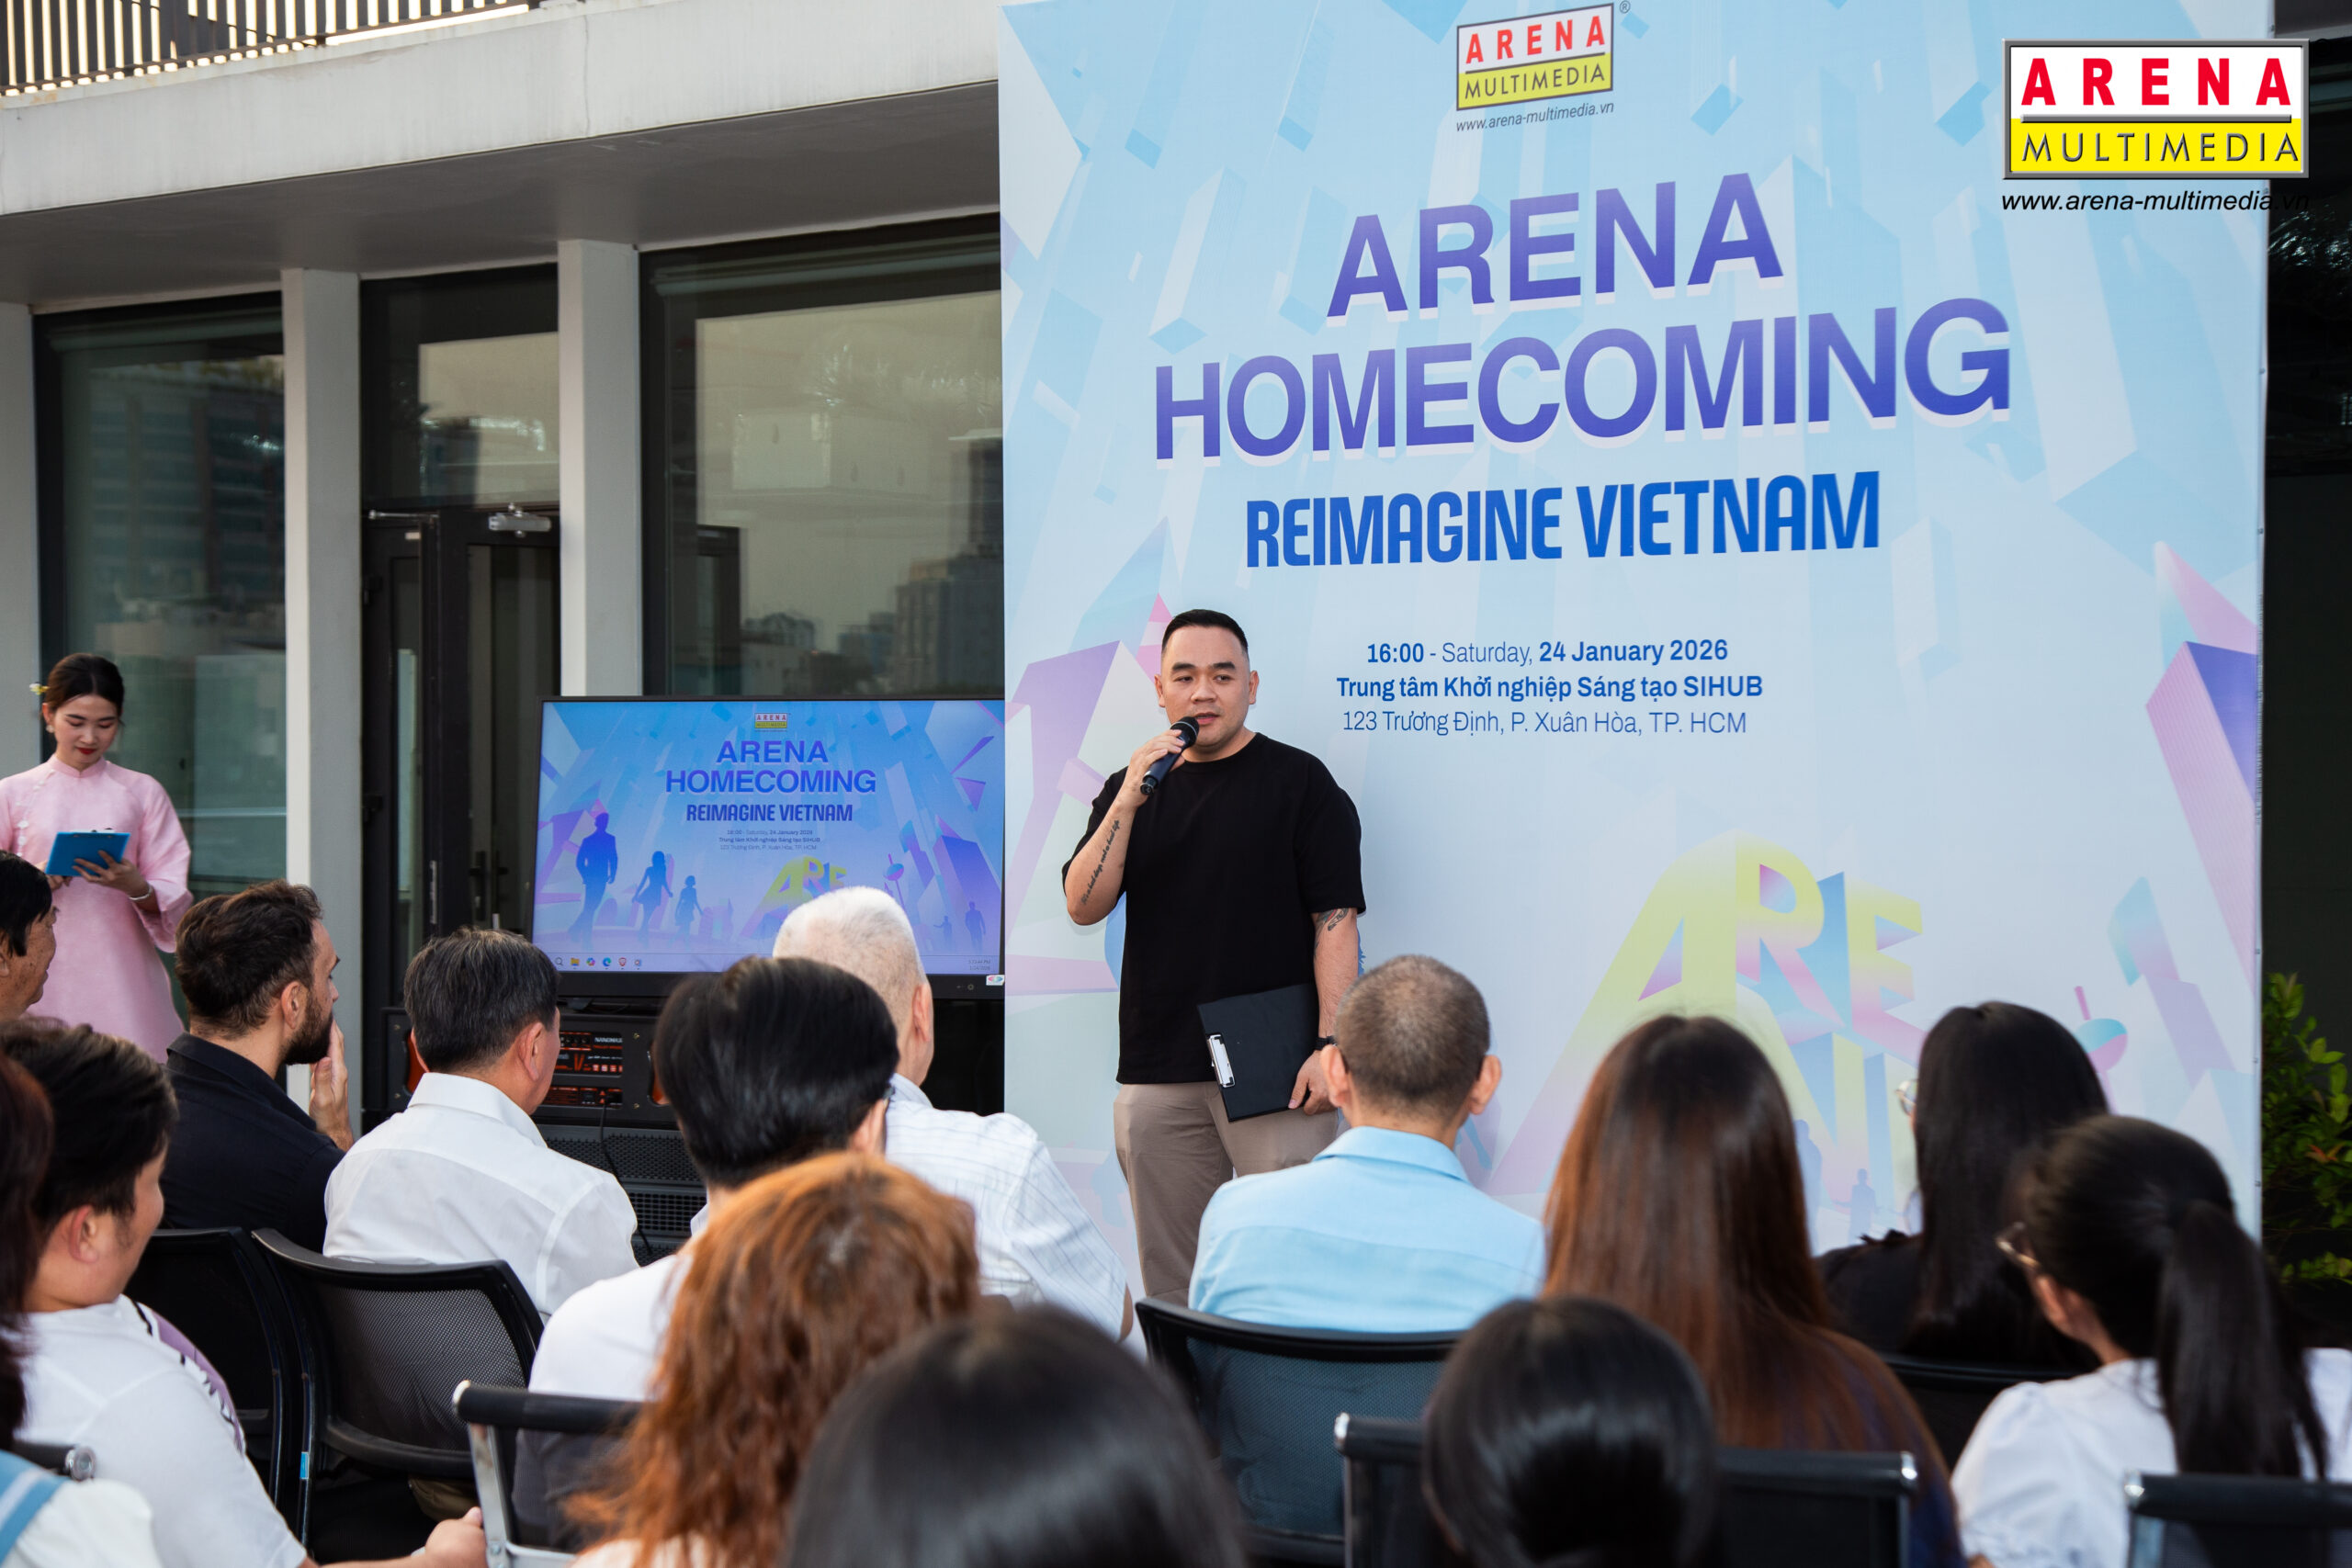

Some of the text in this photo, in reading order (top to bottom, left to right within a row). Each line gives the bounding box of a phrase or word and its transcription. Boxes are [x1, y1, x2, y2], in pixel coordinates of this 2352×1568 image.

[1465, 15, 1606, 64] ARENA
[1464, 62, 1606, 100] MULTIMEDIA
[1456, 102, 1615, 132] www.arena-multimedia.vn
[1327, 173, 1784, 319] ARENA
[1156, 298, 2010, 461] HOMECOMING
[1247, 470, 1881, 568] REIMAGINE VIETNAM
[1367, 642, 1424, 663] 16:00
[1442, 641, 1532, 667] Saturday,
[1539, 641, 1566, 662] 24
[1571, 641, 1665, 666] January
[1670, 638, 1728, 660] 2026
[1336, 675, 1763, 702] Trung tâm Khởi nghiệp Sáng tạo SIHUB
[1343, 710, 1746, 737] 123 Trương Định, P. Xuân Hòa, TP. HCM
[716, 739, 829, 764] ARENA
[665, 769, 876, 795] HOMECOMING
[686, 804, 854, 822] REIMAGINE VIETNAM
